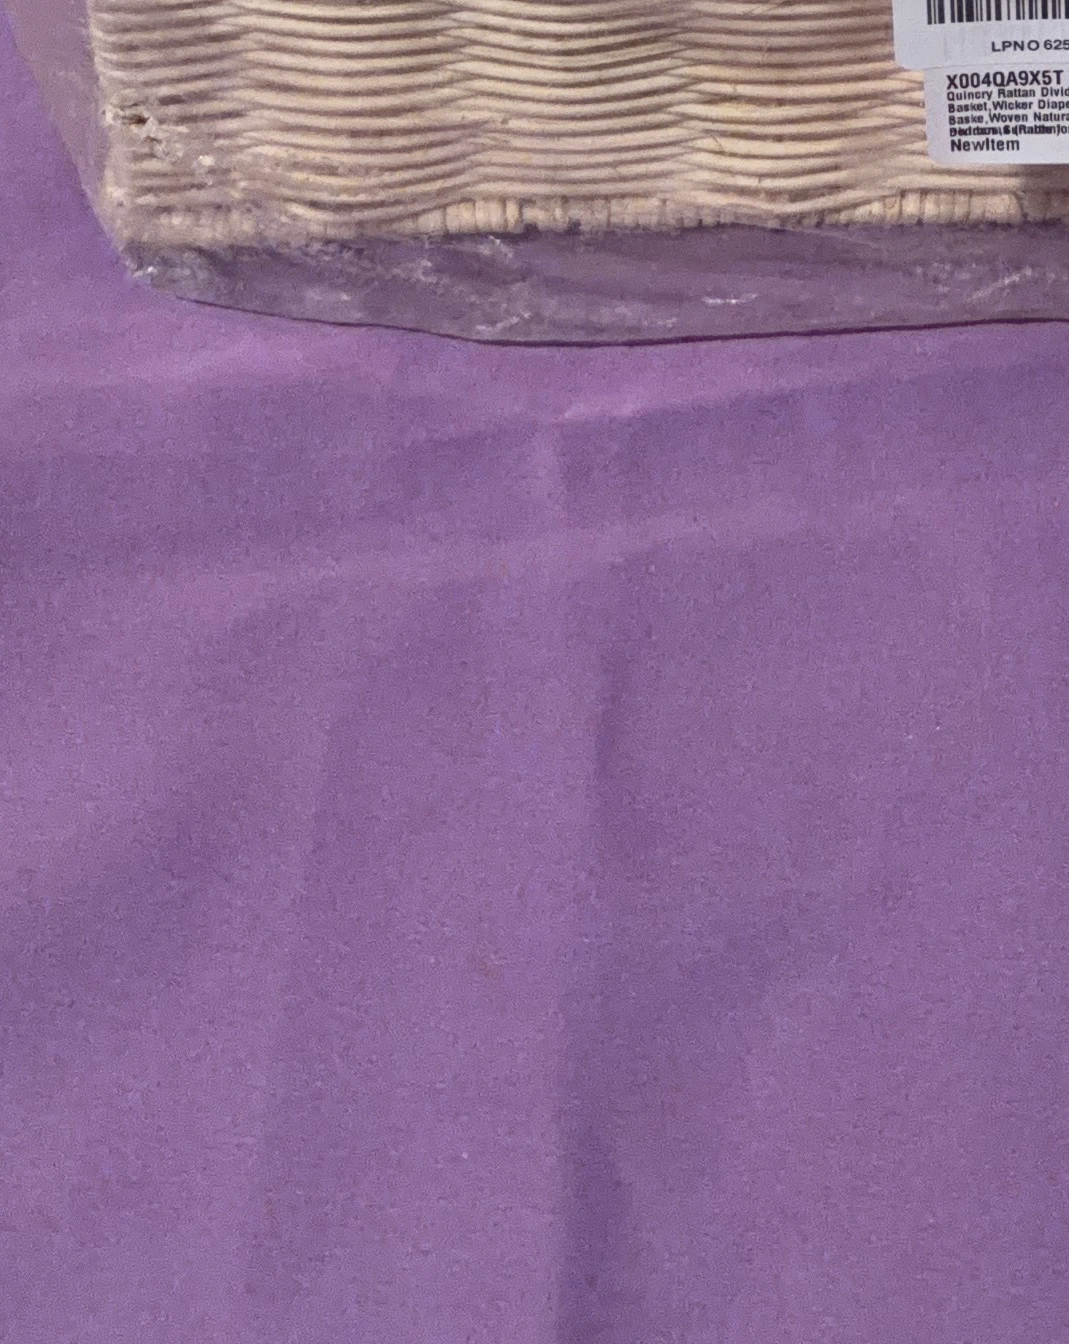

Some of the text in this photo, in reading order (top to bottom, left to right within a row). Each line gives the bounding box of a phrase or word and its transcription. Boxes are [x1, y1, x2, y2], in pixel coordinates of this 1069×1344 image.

[946, 70, 1064, 90] X004QA9X5T
[946, 89, 993, 102] Quincry
[997, 88, 1036, 99] Rattan
[950, 137, 1020, 152] NewItem
